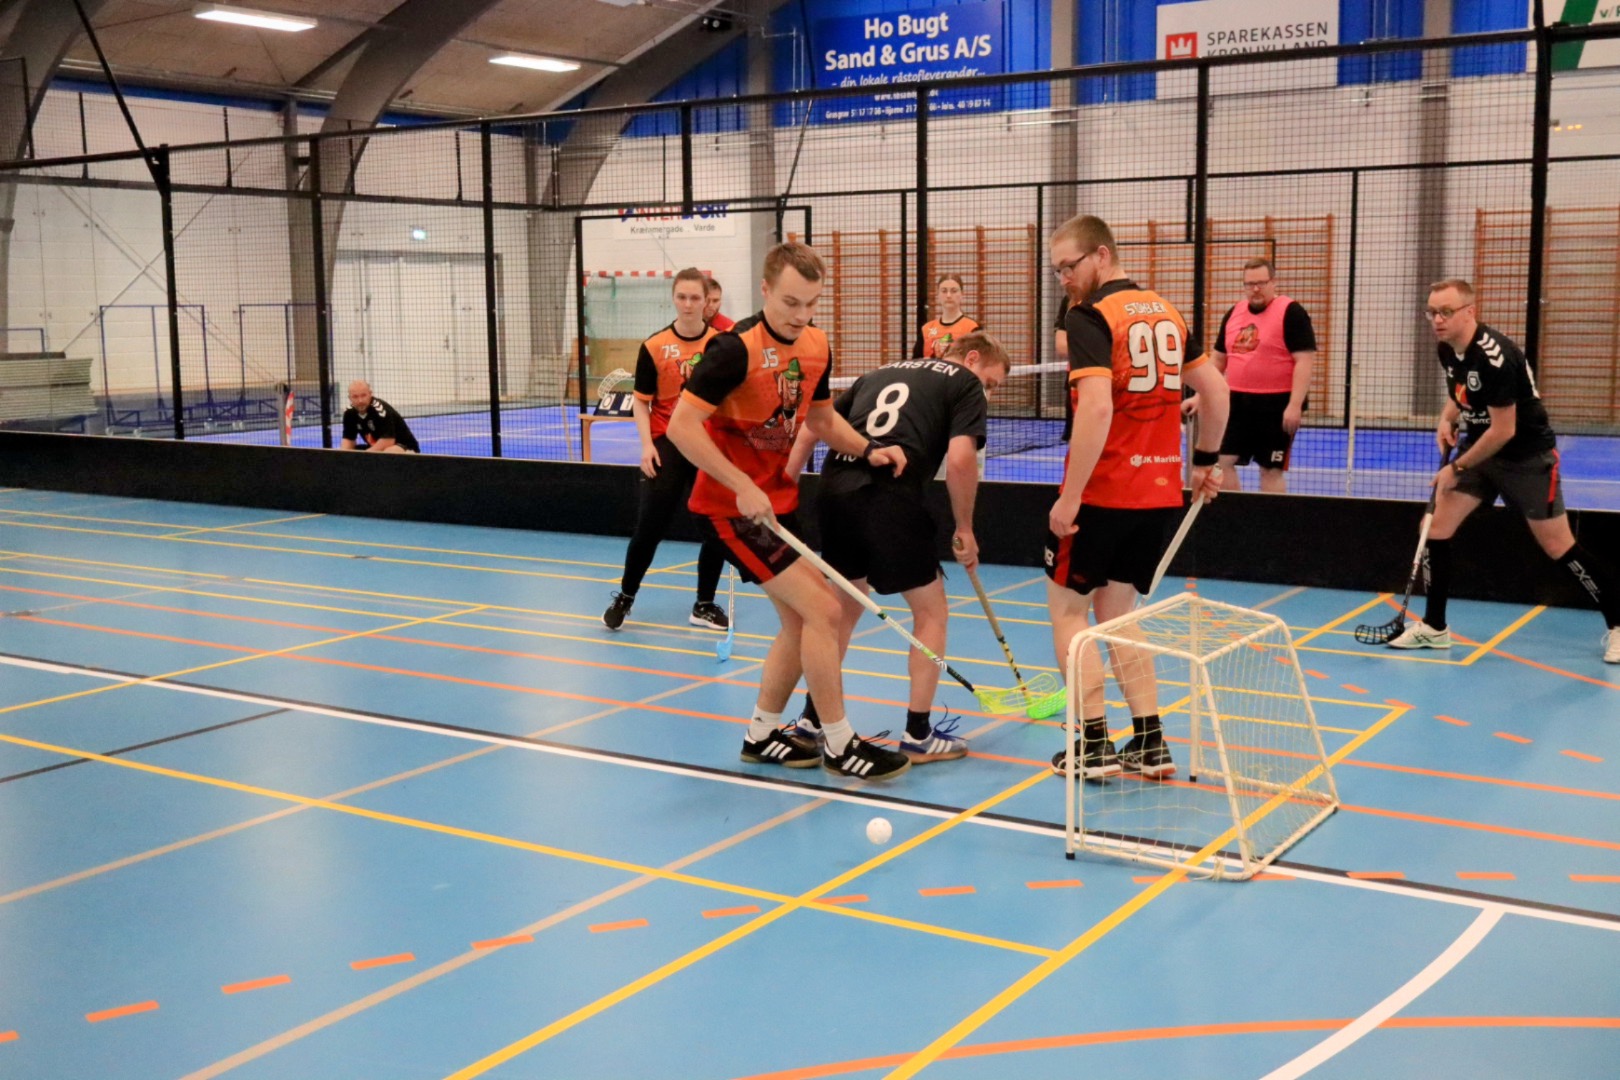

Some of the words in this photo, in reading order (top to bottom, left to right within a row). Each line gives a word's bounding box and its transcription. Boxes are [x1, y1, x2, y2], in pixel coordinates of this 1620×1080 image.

[864, 17, 894, 39] Ho
[898, 12, 949, 39] Bugt
[1206, 21, 1329, 46] SPAREKASSEN
[825, 45, 876, 71] Sand
[880, 44, 896, 65] &
[900, 42, 950, 64] Grus
[954, 34, 992, 59] A/S
[840, 76, 857, 89] din
[860, 72, 889, 87] lokale
[693, 223, 716, 232] Varde
[662, 344, 680, 359] 75
[762, 347, 779, 368] 15
[1127, 320, 1183, 393] 99
[866, 382, 910, 437] 8
